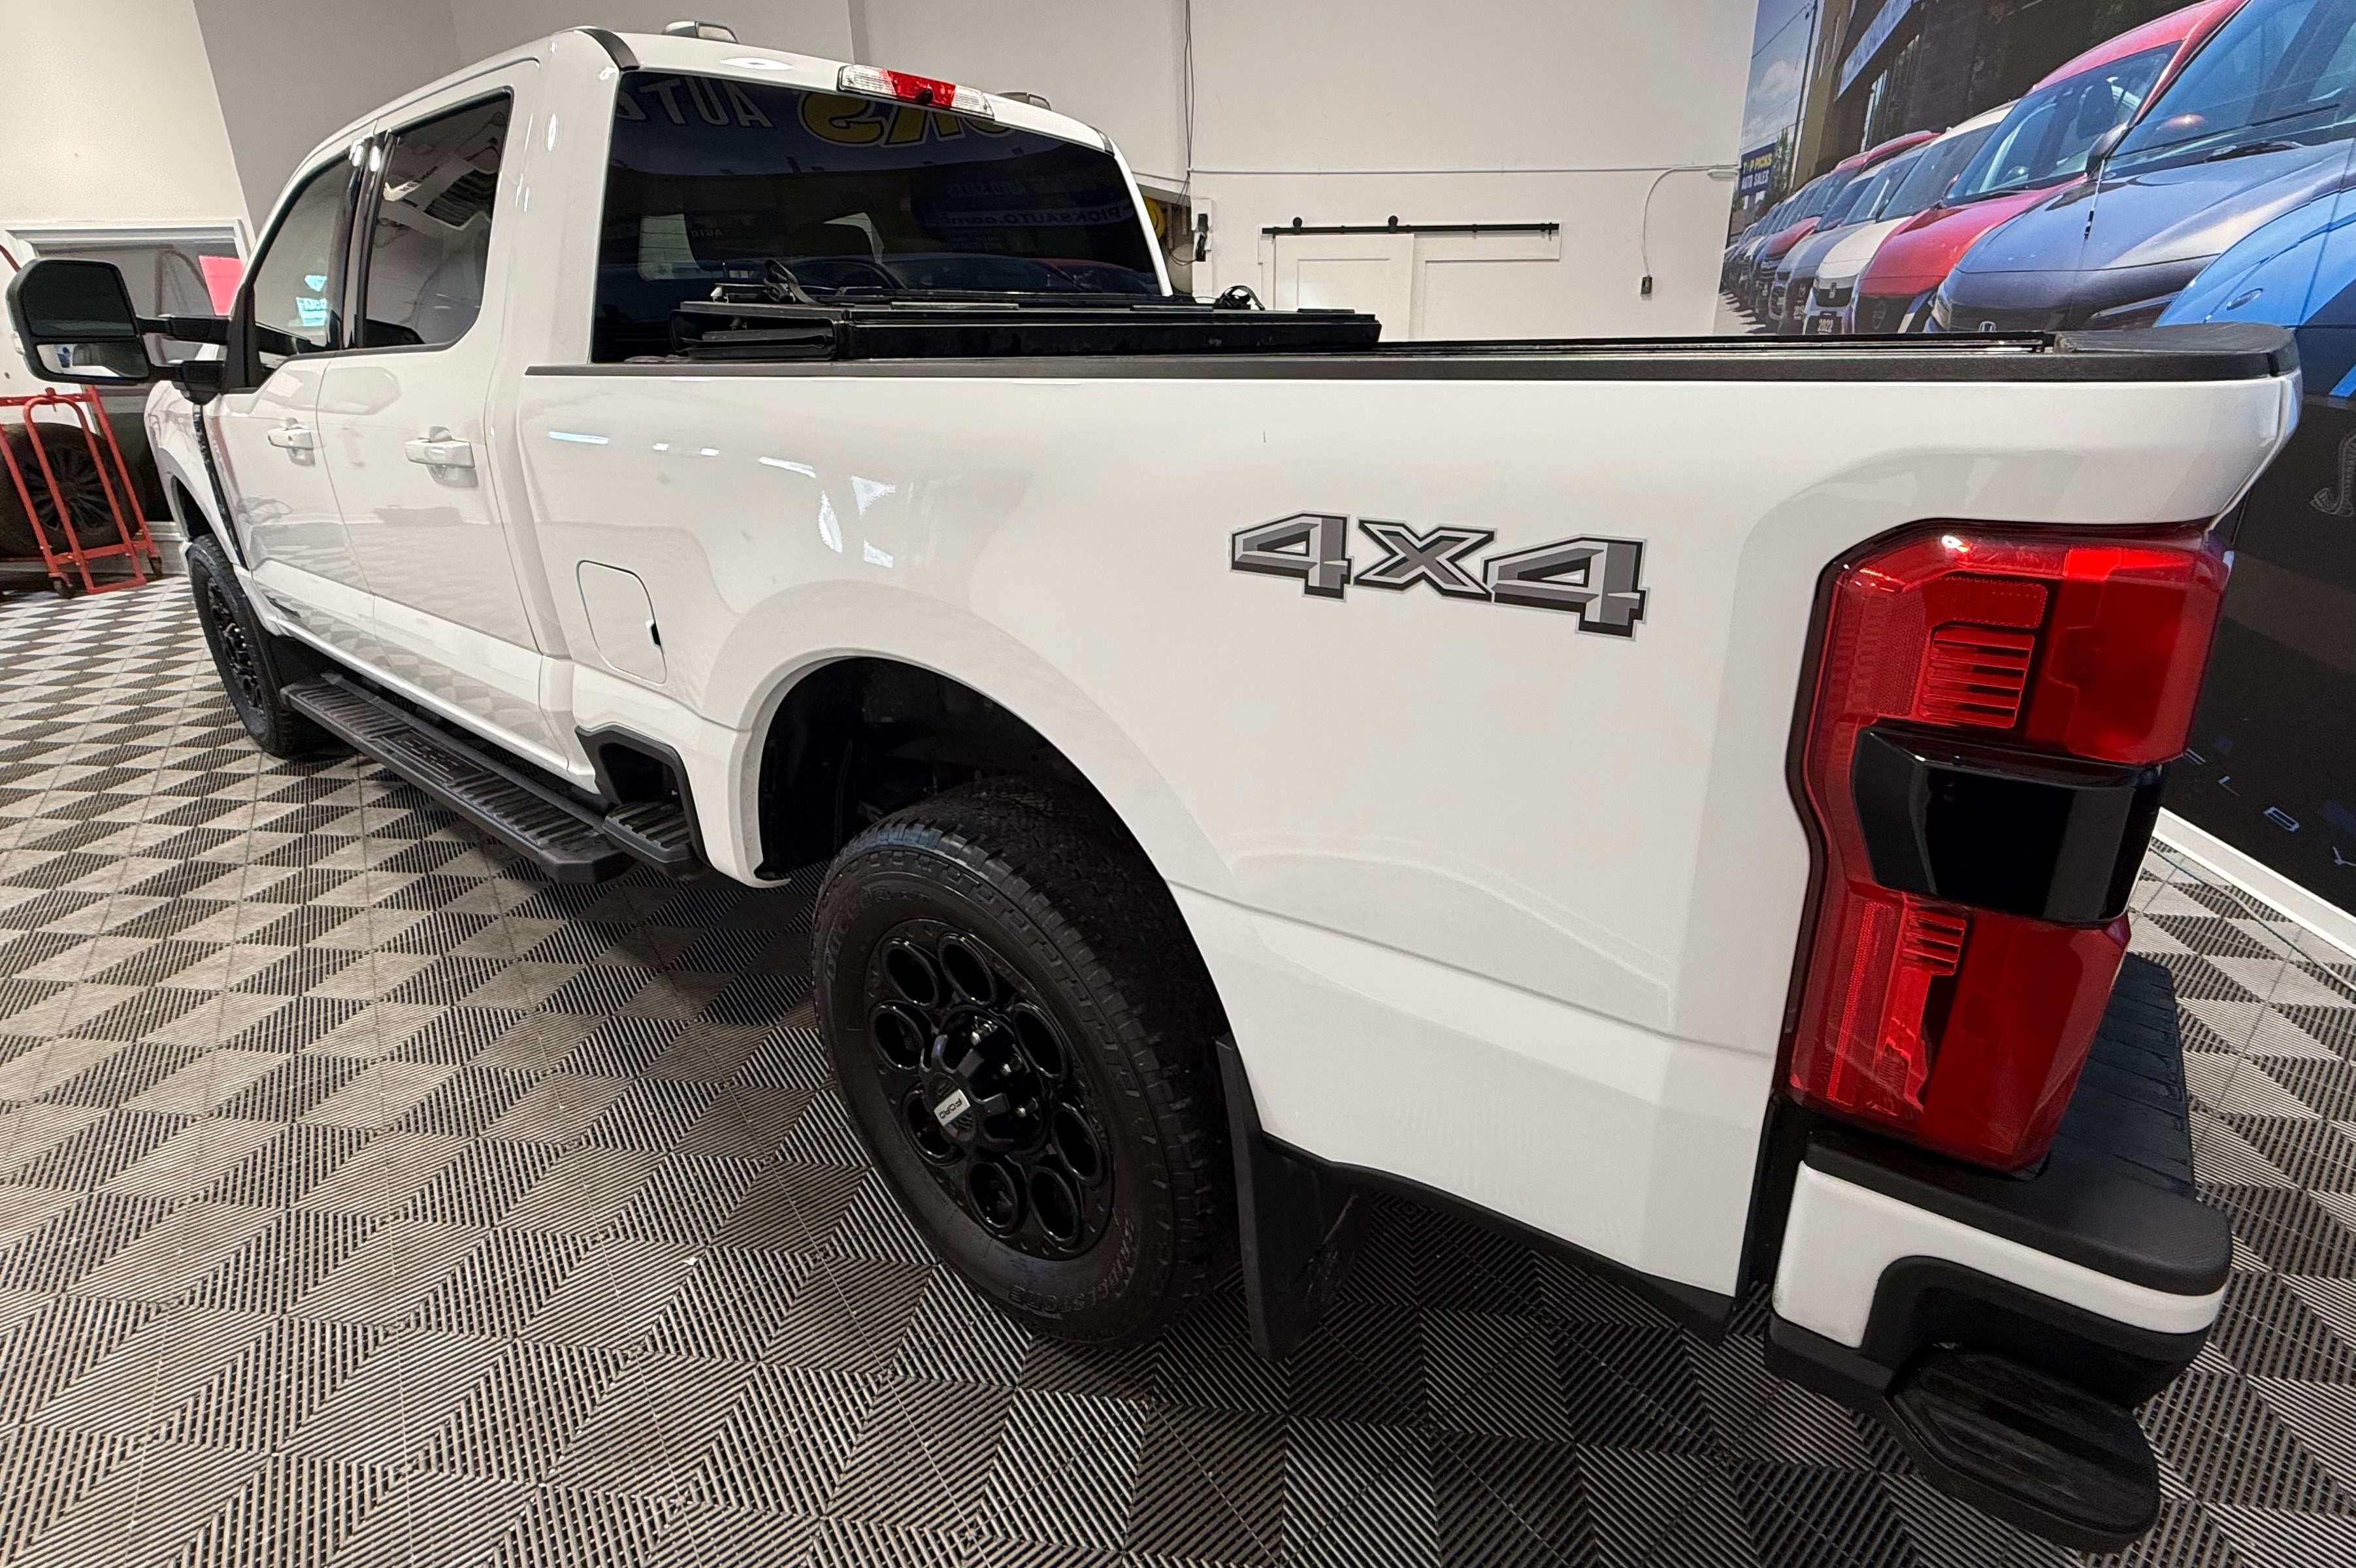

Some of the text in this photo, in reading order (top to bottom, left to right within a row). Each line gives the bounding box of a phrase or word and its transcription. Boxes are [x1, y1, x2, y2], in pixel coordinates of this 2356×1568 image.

[1741, 169, 1770, 190] AUTO SALES
[1818, 318, 1833, 333] 2022
[1229, 510, 1650, 642] 4X4
[938, 1098, 963, 1119] FORD
